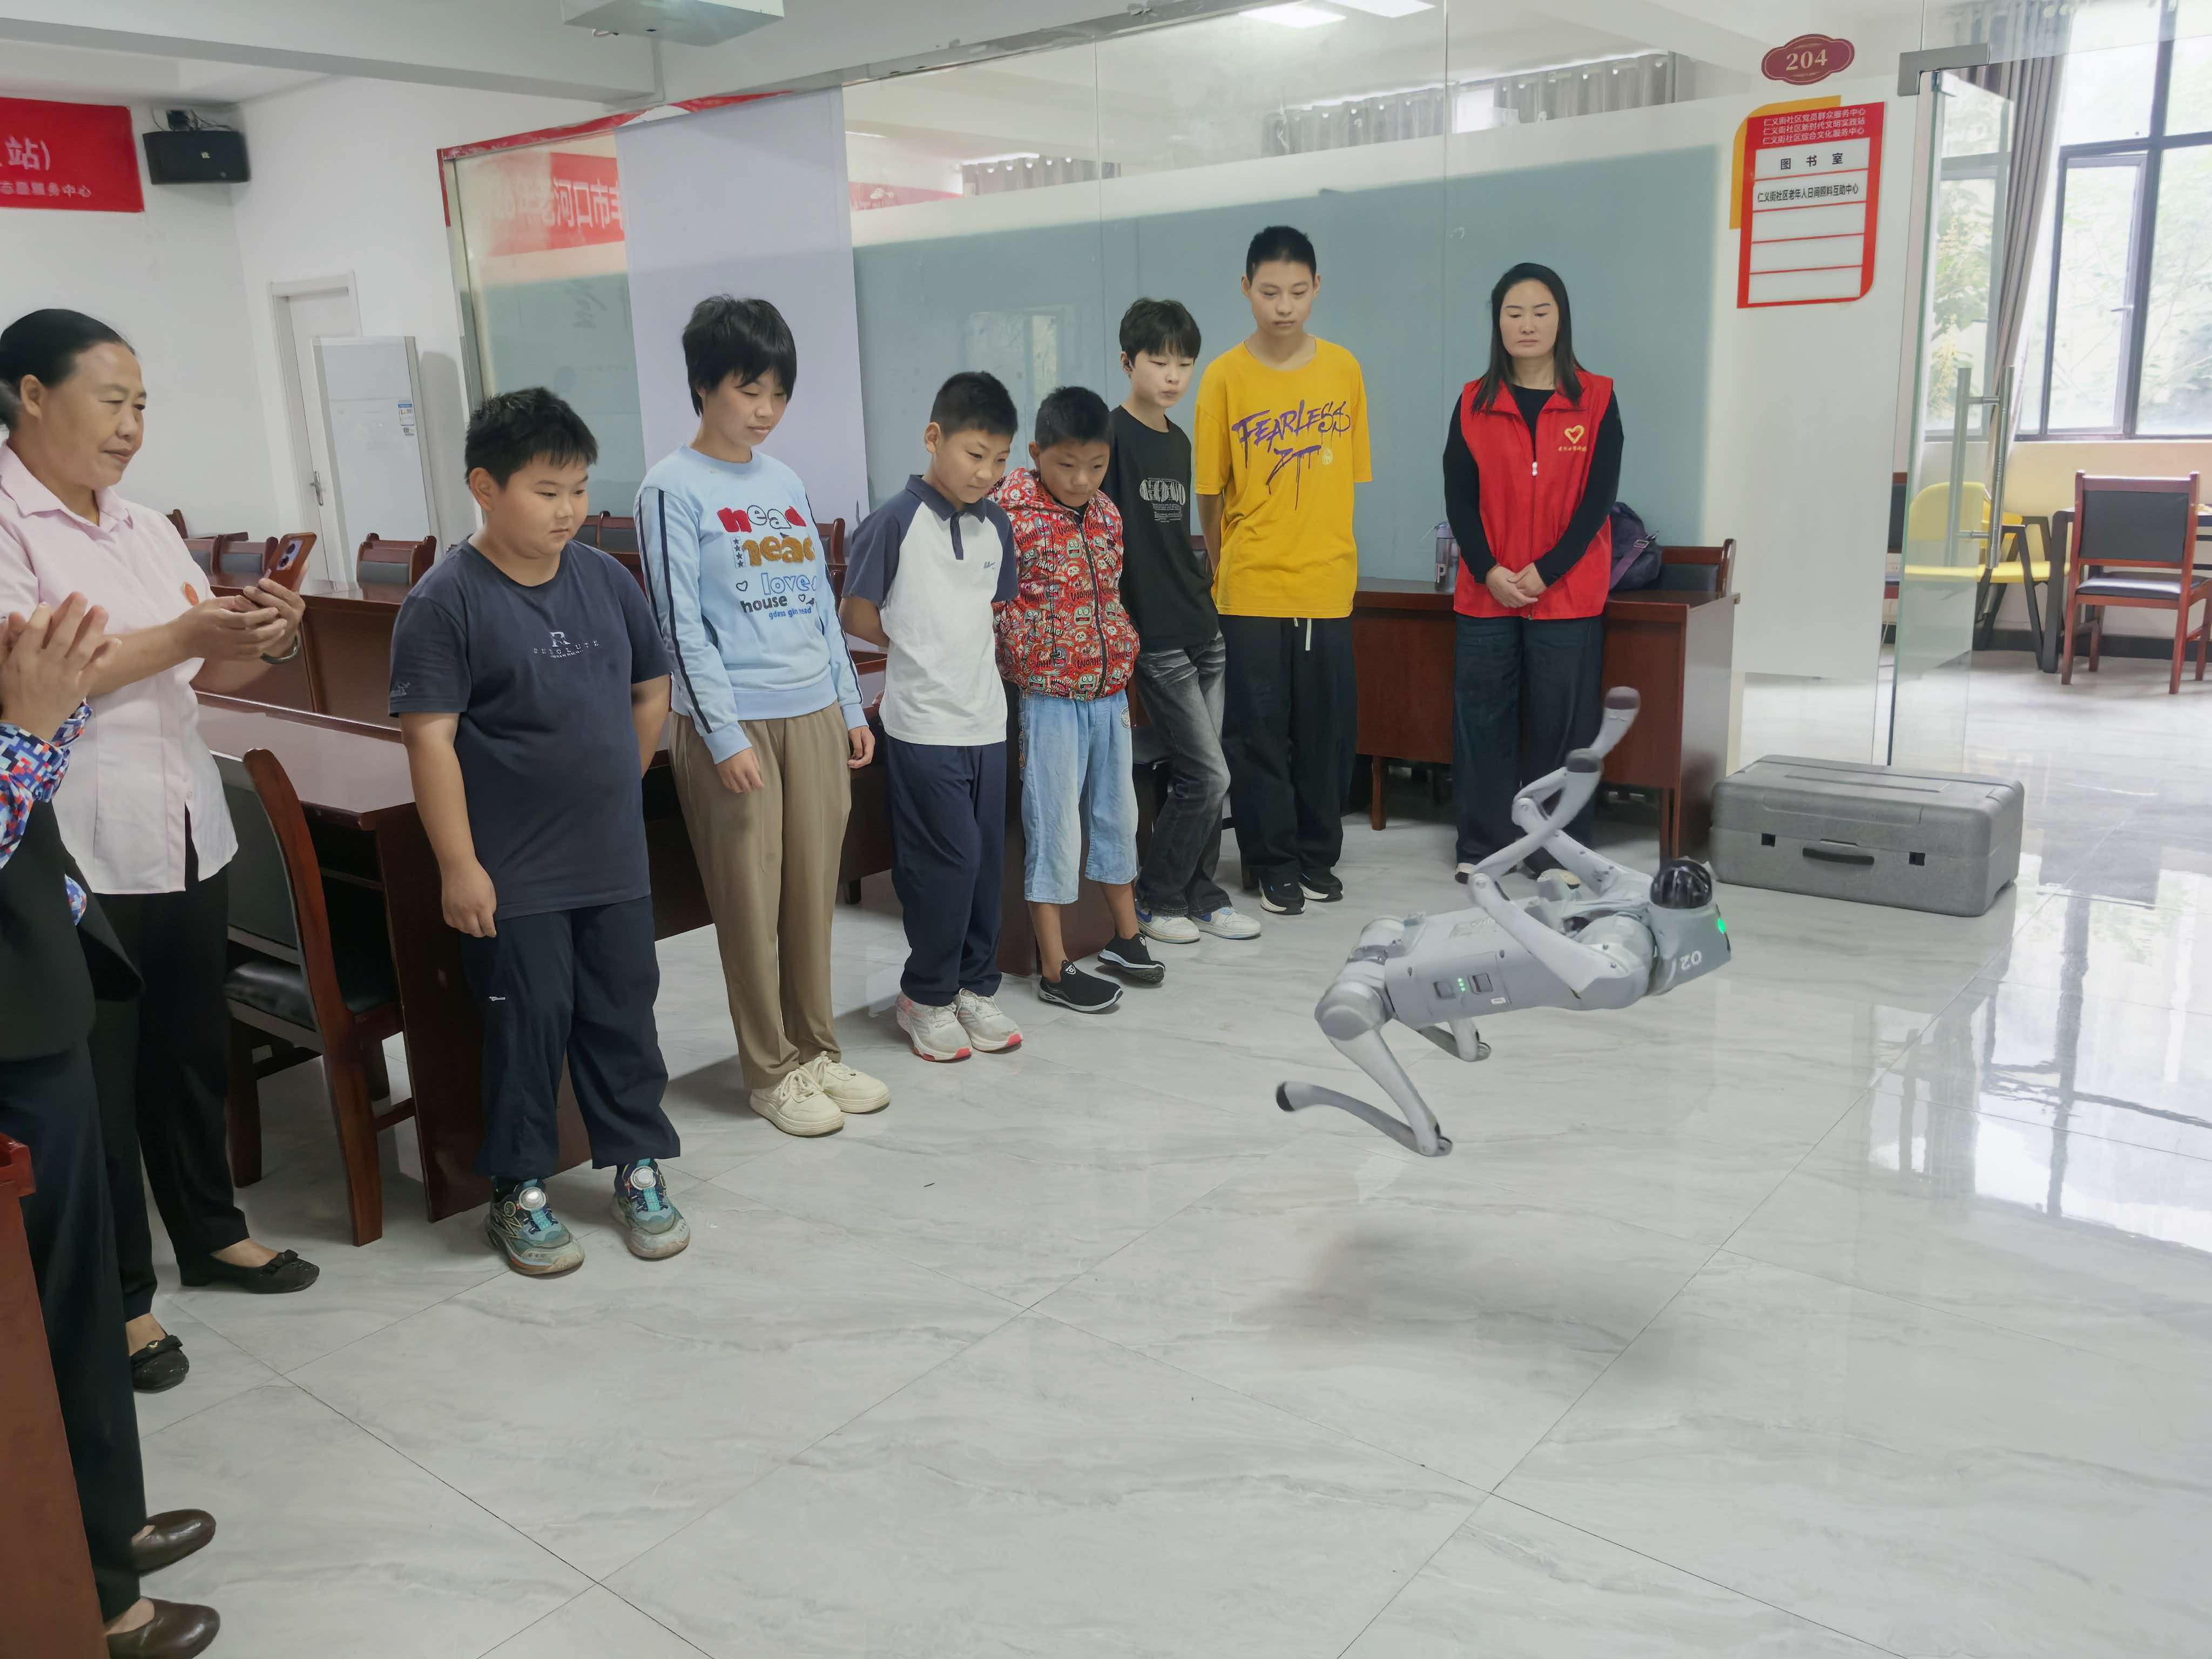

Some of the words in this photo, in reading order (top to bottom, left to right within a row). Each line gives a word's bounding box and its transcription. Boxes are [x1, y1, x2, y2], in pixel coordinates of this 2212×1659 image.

[1786, 49, 1827, 71] 204
[1781, 153, 1843, 170] 图书室
[1757, 184, 1859, 203] 仁义街社区老年人日间照料互助中心
[1231, 400, 1351, 457] FEARLESS
[740, 595, 787, 613] house
[550, 631, 570, 647] R
